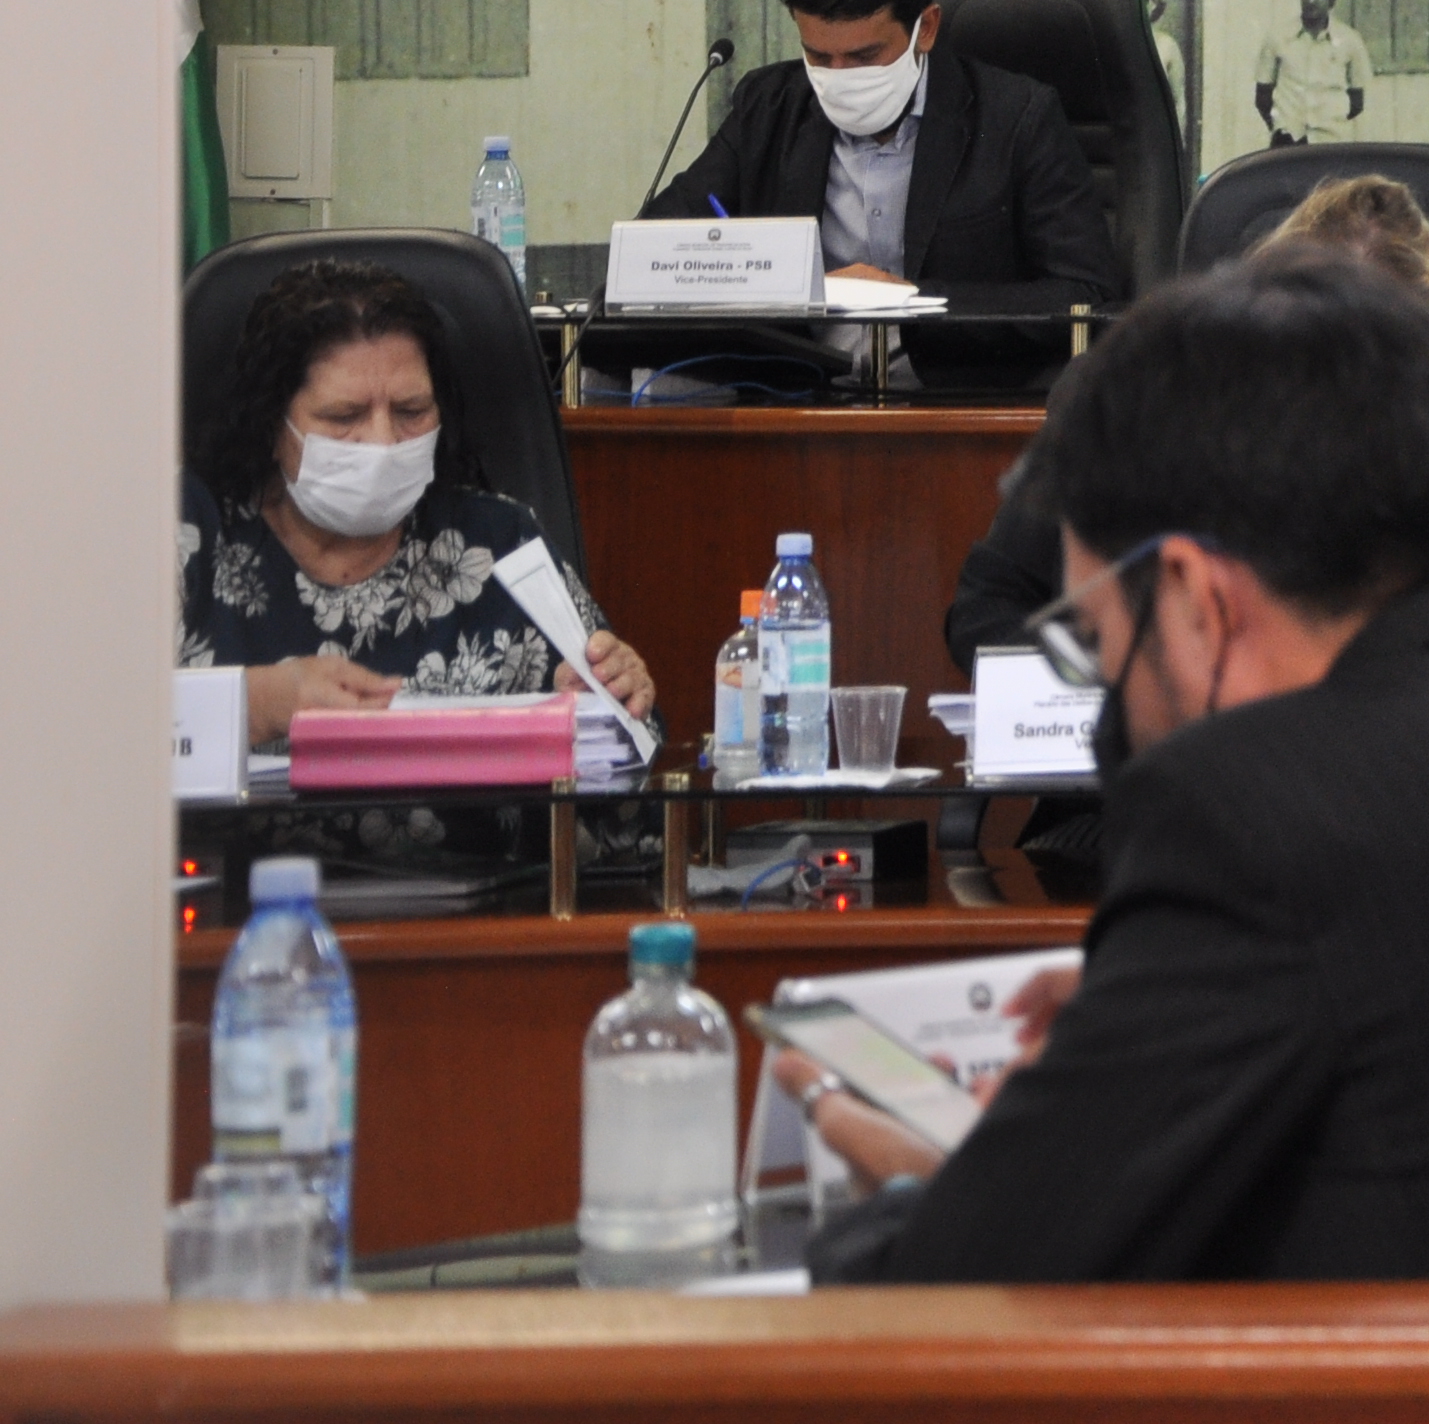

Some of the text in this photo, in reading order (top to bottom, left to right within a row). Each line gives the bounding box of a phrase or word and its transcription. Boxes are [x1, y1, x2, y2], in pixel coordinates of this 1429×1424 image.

[651, 260, 679, 271] Davi
[683, 259, 733, 271] Oliveira
[745, 260, 772, 270] PSB
[674, 274, 748, 284] Vice-Presidente
[1014, 722, 1074, 738] Sandra
